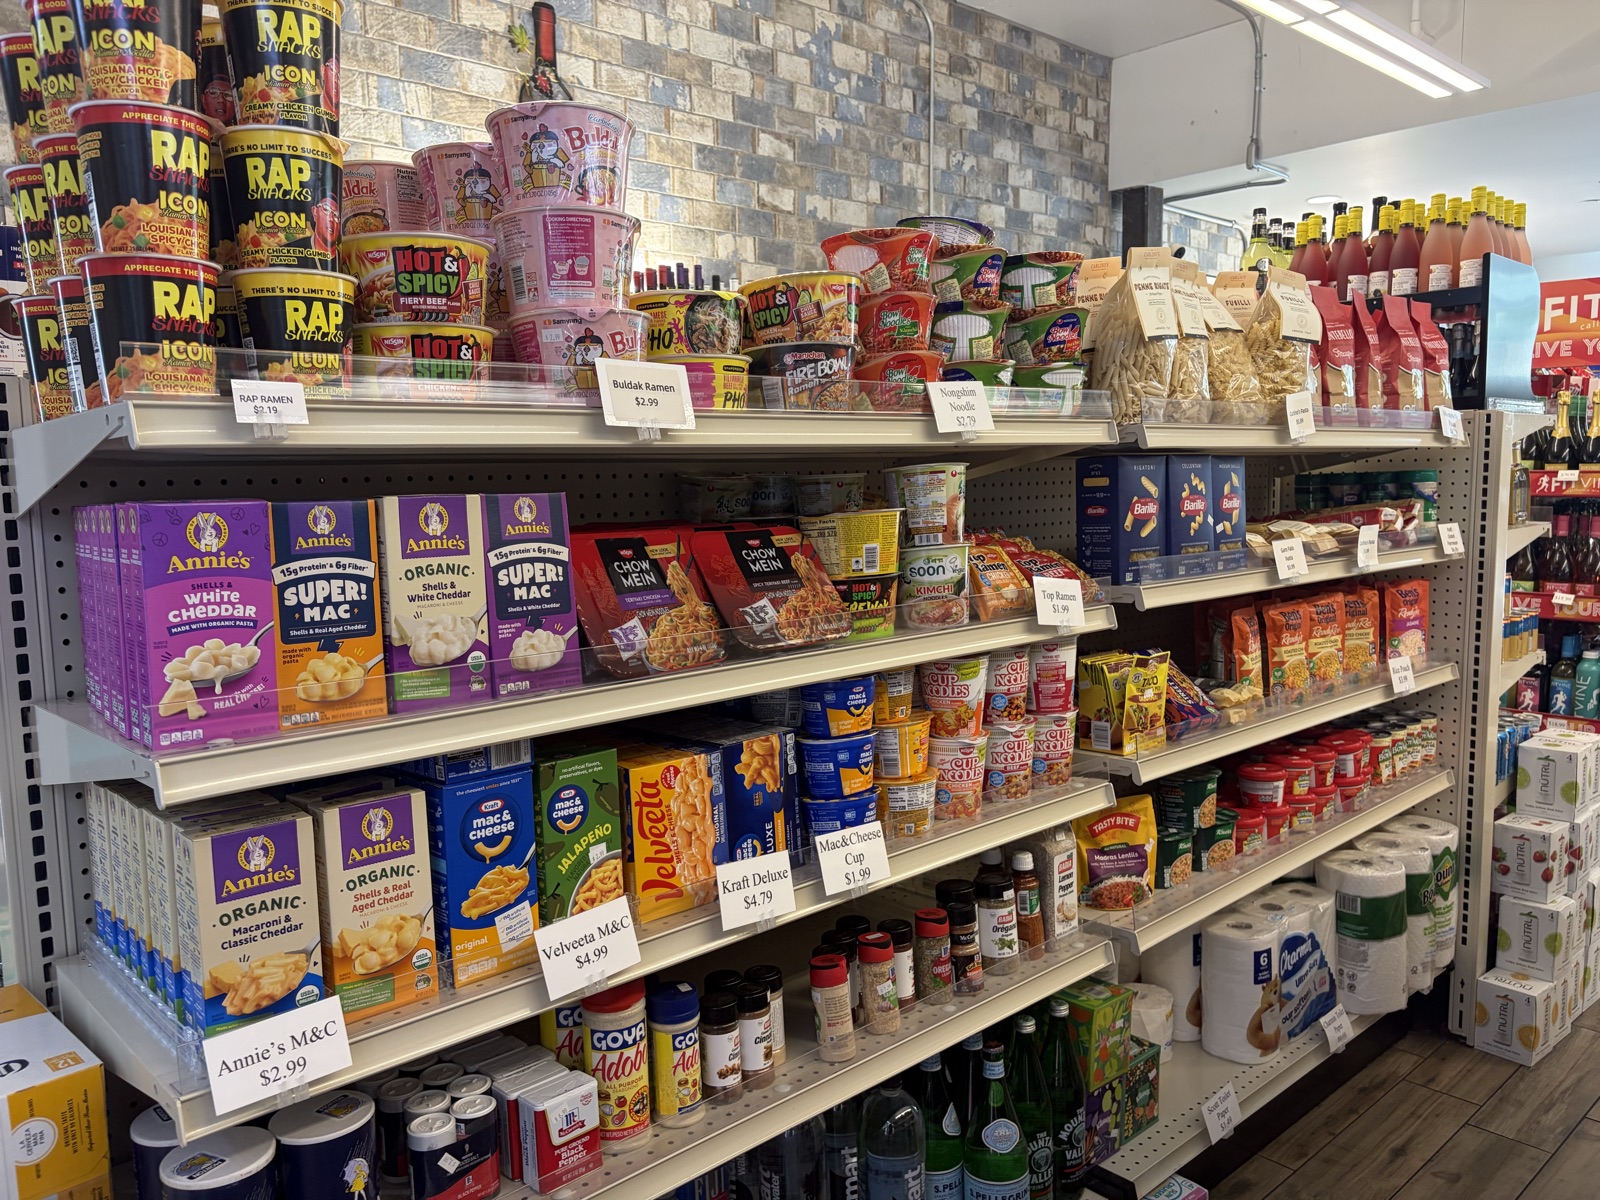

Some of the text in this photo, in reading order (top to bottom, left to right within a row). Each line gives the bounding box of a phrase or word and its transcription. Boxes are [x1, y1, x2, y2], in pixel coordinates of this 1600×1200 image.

[256, 10, 320, 45] RAP
[91, 28, 155, 51] ICON
[264, 64, 316, 85] ICON
[245, 102, 314, 113] CREAMY CHICKEN
[246, 157, 311, 189] RAP
[255, 211, 306, 229] ICON
[267, 248, 304, 256] CHICKEN
[395, 250, 444, 273] HOT
[124, 264, 181, 276] APPRECIATE
[397, 273, 459, 295] SPICY
[302, 288, 324, 296] LIMIT
[153, 281, 215, 323] RAP
[400, 297, 447, 306] FIERY BEEF
[1225, 299, 1251, 307] FUSILLI
[285, 300, 344, 332] RAP
[754, 307, 789, 329] SPICY
[1543, 293, 1600, 332] FIT
[162, 339, 214, 363] ICON
[413, 337, 461, 360] HOT
[792, 352, 825, 360] Maruchan
[1532, 340, 1573, 359] IVE
[414, 358, 474, 381] SPICY
[612, 379, 676, 393] Buldak Ramen
[940, 388, 977, 398] Nongshim
[239, 394, 293, 405] RAP RAMEN
[635, 397, 659, 408] $2.99
[950, 402, 975, 411] Noodle
[253, 405, 278, 415] $2.19
[957, 416, 976, 427] $2.79
[1087, 507, 1105, 515] Barilla
[1134, 503, 1157, 515] Barilla
[1183, 500, 1205, 511] Barilla
[1222, 499, 1240, 509] Barilla
[505, 522, 550, 536] Annie's
[295, 533, 352, 550] Annie's
[405, 534, 466, 554] Annie's
[741, 547, 777, 560] CHOW
[167, 551, 250, 574] Annie's
[613, 559, 651, 574] CHOW
[748, 558, 784, 573] MEIN
[404, 562, 471, 582] ORGANIC
[497, 562, 564, 587] SUPER!
[908, 563, 946, 578] soon
[191, 582, 224, 590] SHELLS
[422, 582, 448, 592] Shells
[620, 572, 657, 588] MEIN
[852, 583, 871, 592] HOT
[283, 578, 368, 606] SUPER!
[407, 590, 471, 604] White Cheddar
[514, 584, 552, 601] MAC
[852, 591, 877, 601] SPICY
[915, 584, 953, 595] KIMCHI
[1042, 590, 1077, 602] Top Ramen
[1396, 588, 1418, 599] Ben's
[303, 604, 351, 622] MAC
[1052, 604, 1070, 615] $1.99
[1315, 603, 1336, 615] Ben's
[172, 620, 254, 634] MADE WITH ORGANIC PASTA
[289, 623, 367, 637] Shells Real Aged Cheddar
[282, 653, 305, 662] organic
[1392, 665, 1401, 674] Rice
[929, 673, 960, 686] CUP
[922, 682, 969, 698] NOODLES
[1045, 728, 1072, 742] CUP
[1002, 739, 1030, 753] CUP
[950, 757, 980, 770] CUP
[991, 750, 1034, 765] NOODLES
[938, 768, 984, 782] NOODLES
[1092, 817, 1136, 834] TASTY BITE
[634, 778, 684, 903] Velveeta
[817, 829, 883, 855] Mac&Cheese
[347, 834, 411, 865] Annie's
[557, 823, 613, 875] JALAPEÑO
[1094, 851, 1139, 861] Madras Lentils
[844, 853, 866, 868] Cup
[221, 864, 296, 898] Annie's
[345, 863, 416, 893] ORGANIC
[721, 868, 790, 896] Kraft Deluxe
[844, 867, 872, 885] $1.99
[353, 880, 411, 903] Shells Real
[351, 890, 414, 915] Aged Cheddar
[743, 890, 774, 910] $4.79
[218, 895, 302, 928] ORGANIC
[233, 918, 283, 938] Macaroni
[221, 922, 304, 952] Classic Cheddar
[455, 935, 488, 952] original
[541, 915, 631, 961] Velveeta M&C
[575, 944, 609, 970] $4.99
[1259, 952, 1269, 965] 6
[593, 1021, 646, 1051] GOYA
[217, 1019, 338, 1078] Annie's M&C
[259, 1055, 308, 1088] $2.99
[605, 1075, 645, 1091] ALL PURPOSE
[1207, 1089, 1232, 1115] Scott Toilet
[1216, 1106, 1230, 1121] Paper
[1220, 1115, 1233, 1132] $1.49
[1036, 1130, 1048, 1139] THE
[567, 1136, 590, 1150] GROUND
[557, 1150, 588, 1168] Pepper
[561, 1146, 585, 1160] Black
